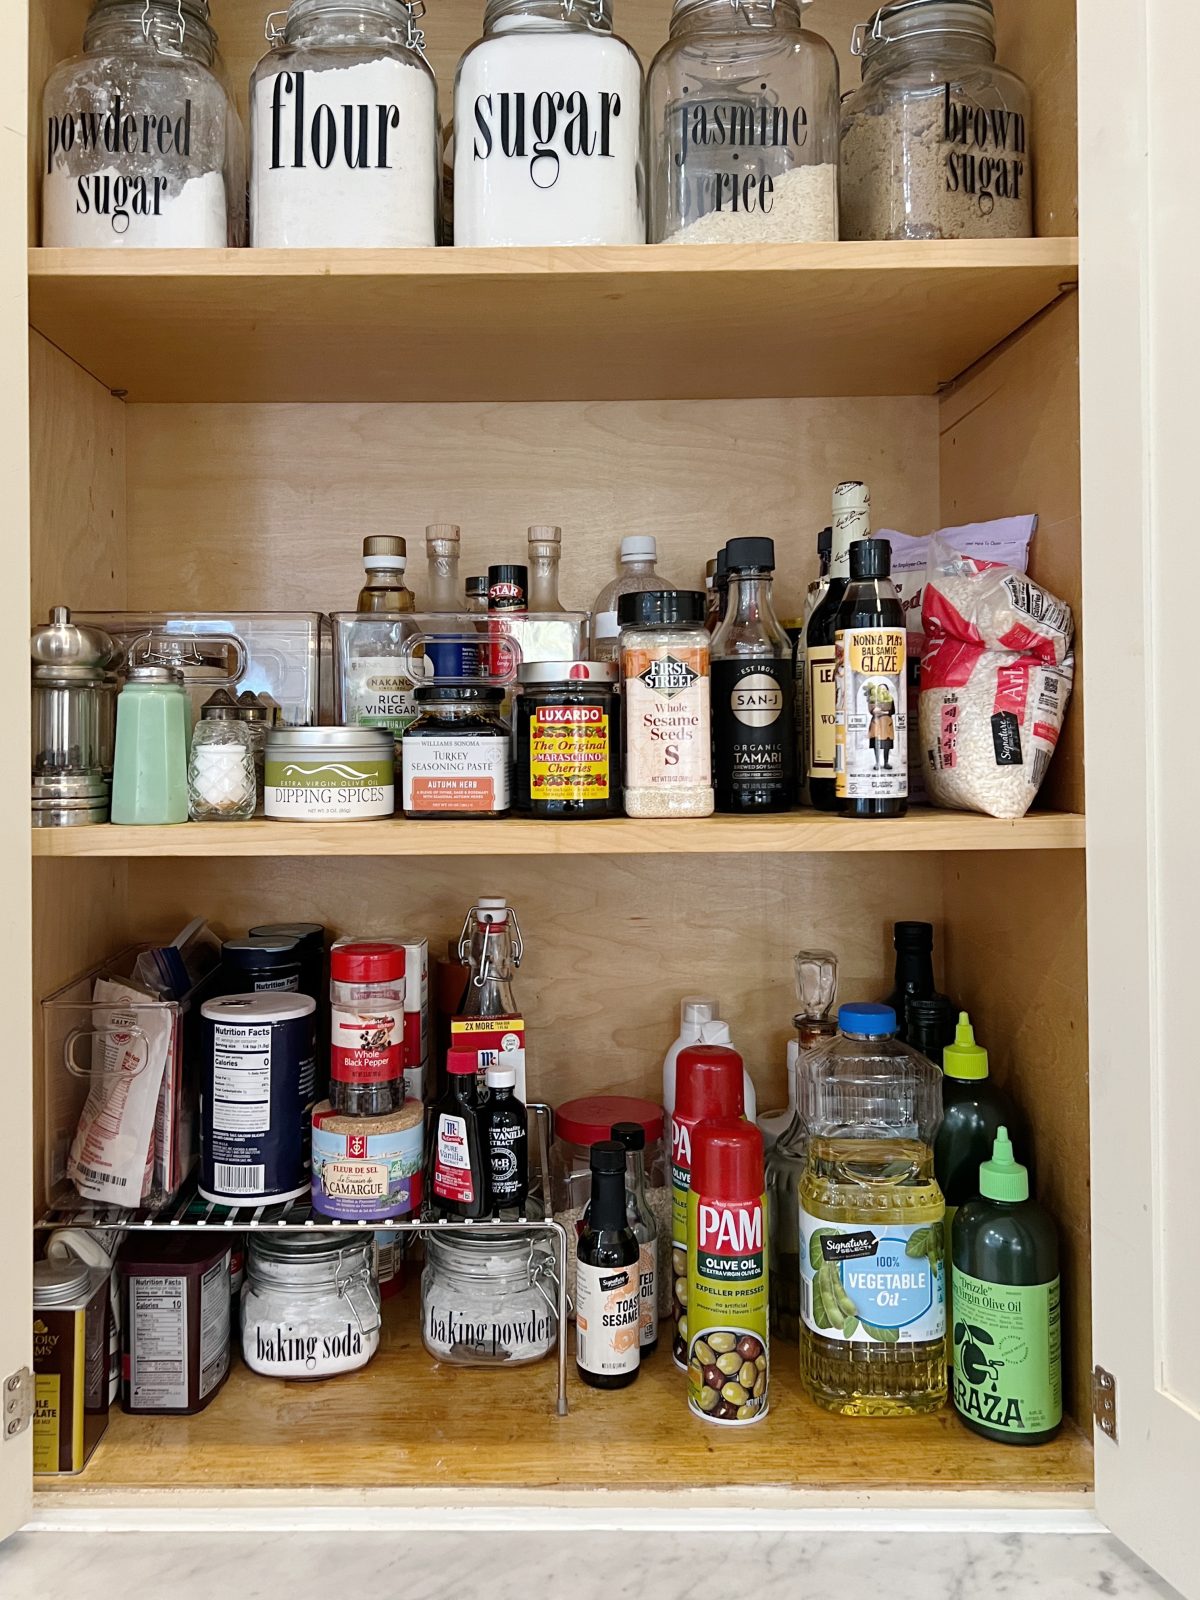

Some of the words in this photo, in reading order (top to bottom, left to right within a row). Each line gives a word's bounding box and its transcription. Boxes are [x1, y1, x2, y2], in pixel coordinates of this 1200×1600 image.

[268, 71, 400, 169] flour
[941, 82, 1026, 153] brown
[676, 83, 807, 166] jasmine
[48, 94, 191, 174] powdered
[473, 89, 620, 188] sugar
[714, 154, 774, 213] rice
[945, 153, 1025, 215] sugar
[76, 172, 168, 234] sugar
[490, 585, 519, 598] STAR
[853, 635, 884, 646] NONNA
[861, 647, 897, 656] BALSAMIC
[650, 660, 689, 675] FIRST
[740, 665, 755, 674] EST
[861, 656, 898, 673] GLAZE
[644, 674, 694, 688] STREET
[378, 695, 406, 704] RICE
[736, 695, 779, 705] SAN-J
[365, 706, 416, 714] VINEGAR
[655, 703, 688, 713] Whole
[538, 709, 600, 721] LUXARDO
[643, 713, 699, 727] Sesame
[651, 727, 693, 741] Seeds
[1000, 718, 1013, 761] Signature
[533, 741, 553, 751] The
[558, 740, 606, 752] Original
[537, 753, 601, 761] MARASCHINO
[664, 744, 680, 765] S
[733, 753, 782, 763] TAMARI
[411, 762, 465, 771] SEASONING
[467, 762, 494, 771] PASTE
[548, 763, 592, 773] Cherries
[367, 778, 379, 786] OIL
[428, 780, 457, 789] AUTUMN
[459, 780, 478, 788] HERB
[275, 788, 332, 804] DIPPING
[337, 787, 385, 803] SPICES
[256, 979, 288, 990] Nutrition
[215, 1026, 246, 1036] Nutrition
[248, 1027, 270, 1037] Facts
[465, 1022, 475, 1031] 2X
[475, 1020, 495, 1031] MORE
[354, 1050, 380, 1058] Whole
[215, 1058, 238, 1067] Calories
[263, 1058, 269, 1066] 0
[344, 1057, 363, 1068] Black
[364, 1057, 390, 1068] Pepper
[493, 1129, 526, 1141] VANILLA
[501, 1125, 521, 1133] Quality
[671, 1119, 692, 1165] PA
[440, 1150, 464, 1162] Vanilla
[333, 1165, 354, 1174] FLEUR
[354, 1166, 365, 1174] DE
[366, 1166, 379, 1174] SEL
[328, 1181, 384, 1195] CAMARGUE
[699, 1204, 762, 1252] PAM
[826, 1238, 870, 1254] Signature
[841, 1246, 869, 1254] SELECT
[706, 1257, 738, 1271] OLIVE
[740, 1258, 757, 1270] OIL
[876, 1256, 900, 1268] 100%
[706, 1268, 723, 1277] EXTRA
[722, 1270, 741, 1278] VIRGIN
[741, 1269, 755, 1277] OLIVE
[848, 1272, 926, 1290] VEGETABLE
[641, 1284, 654, 1298] OIL
[695, 1282, 734, 1297] EXPELLER
[734, 1284, 766, 1297] PRESSED
[136, 1301, 159, 1309] Calories
[173, 1300, 182, 1309] 10
[876, 1290, 899, 1307] Oil
[960, 1287, 981, 1305] Virgin
[982, 1297, 1006, 1311] Olive
[1007, 1301, 1022, 1312] Oil
[602, 1308, 638, 1327] SESAME
[431, 1305, 488, 1354] baking
[492, 1309, 552, 1357] powder
[256, 1326, 318, 1370] baking
[322, 1323, 362, 1359] soda
